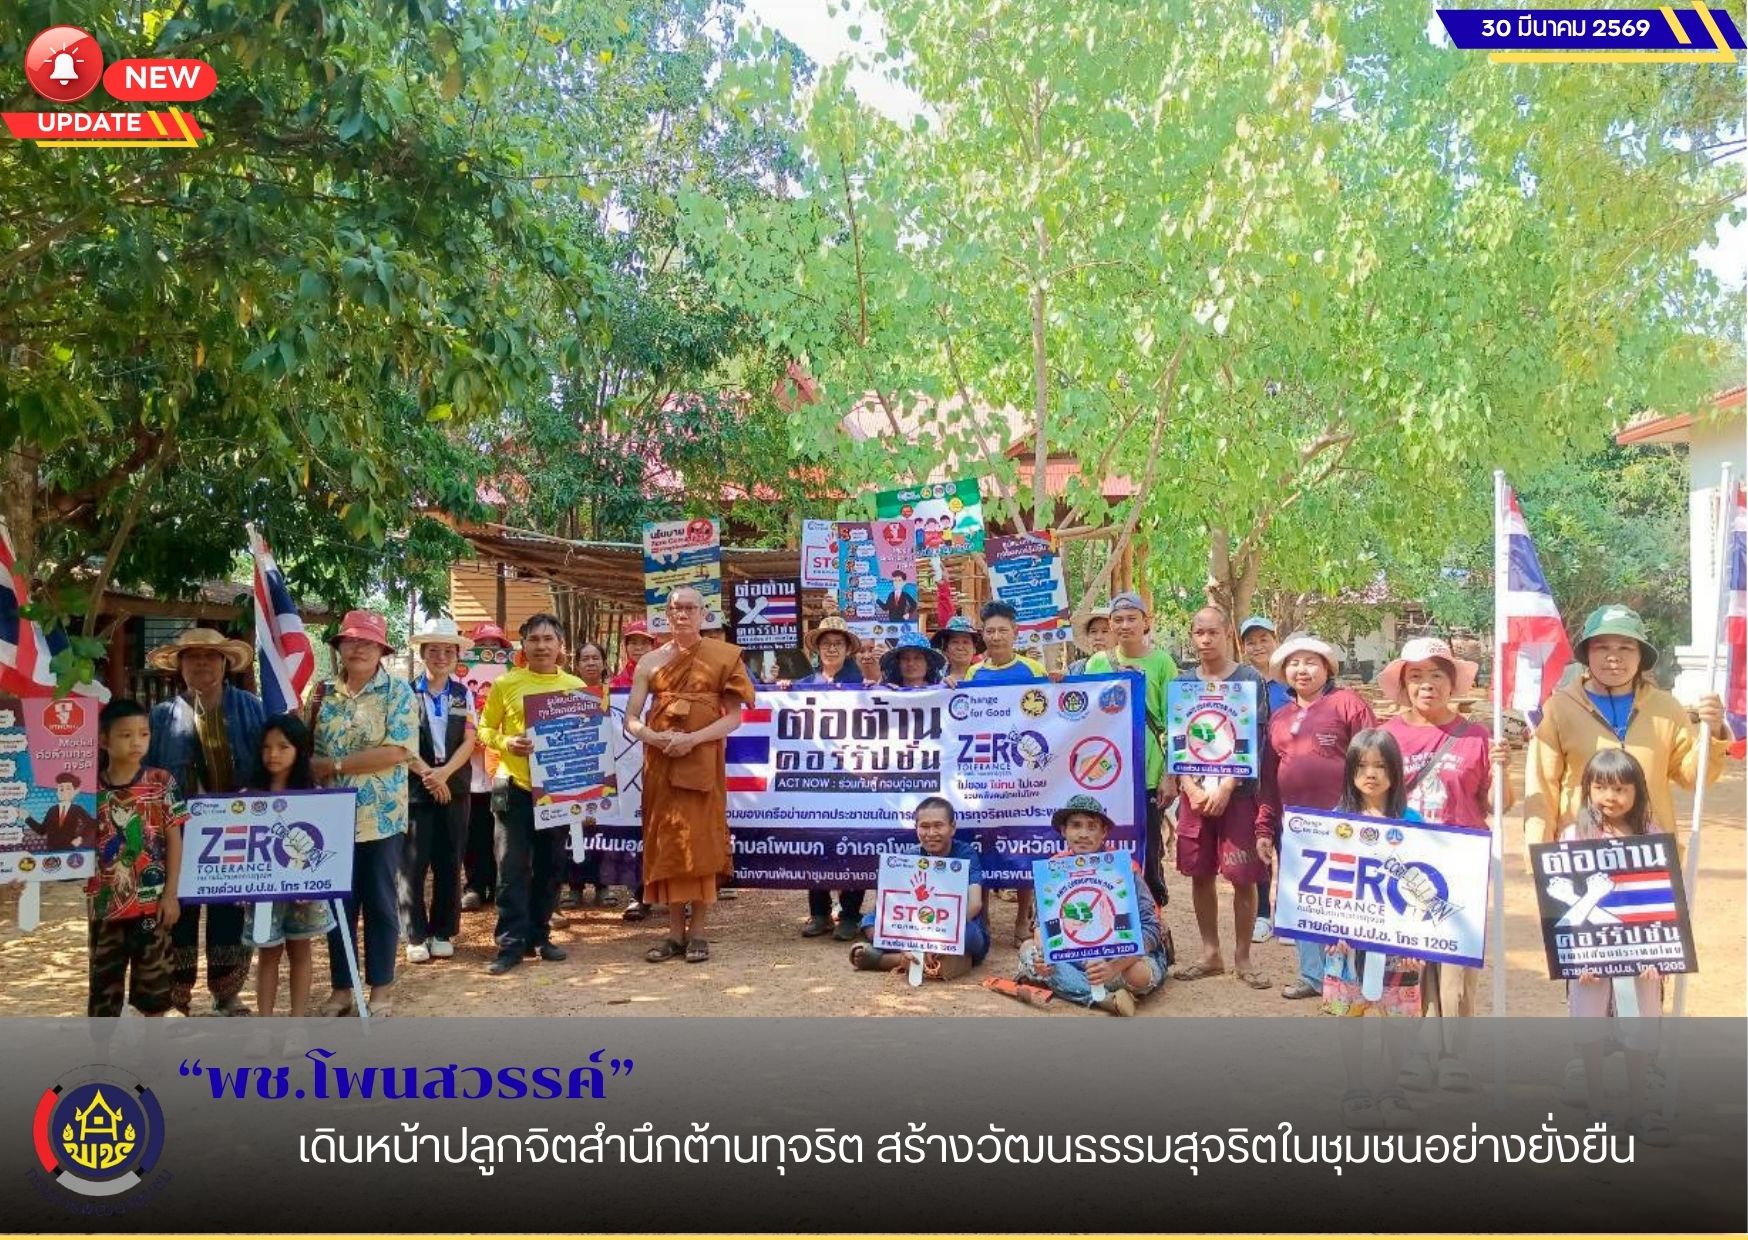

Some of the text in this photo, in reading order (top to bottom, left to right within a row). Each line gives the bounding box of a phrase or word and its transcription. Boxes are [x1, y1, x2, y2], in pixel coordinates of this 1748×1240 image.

[735, 580, 796, 597] ต่อต้าน
[777, 697, 942, 740] ต่อต้าน
[970, 708, 1011, 718] for Good
[776, 740, 941, 770] คอร์รัปชั่น
[957, 730, 1049, 767] ZERO
[777, 777, 800, 788] ACT
[802, 777, 830, 788] NOW
[199, 821, 325, 870] ZERO
[1541, 840, 1667, 875] ต่อต้าน
[197, 863, 273, 874] TOLERANCE
[197, 882, 243, 895] สายด่วน
[280, 880, 301, 892] โทร
[303, 880, 332, 890] 1205
[1298, 849, 1449, 917] ZERO
[893, 905, 950, 924] STOP
[1297, 893, 1386, 917] TOLERANCE
[1297, 917, 1458, 952] สายด่วน ป.ป.ช. โทร 1205
[1555, 921, 1680, 948] คอร์รัปชั่น
[1658, 961, 1686, 971] 1205
